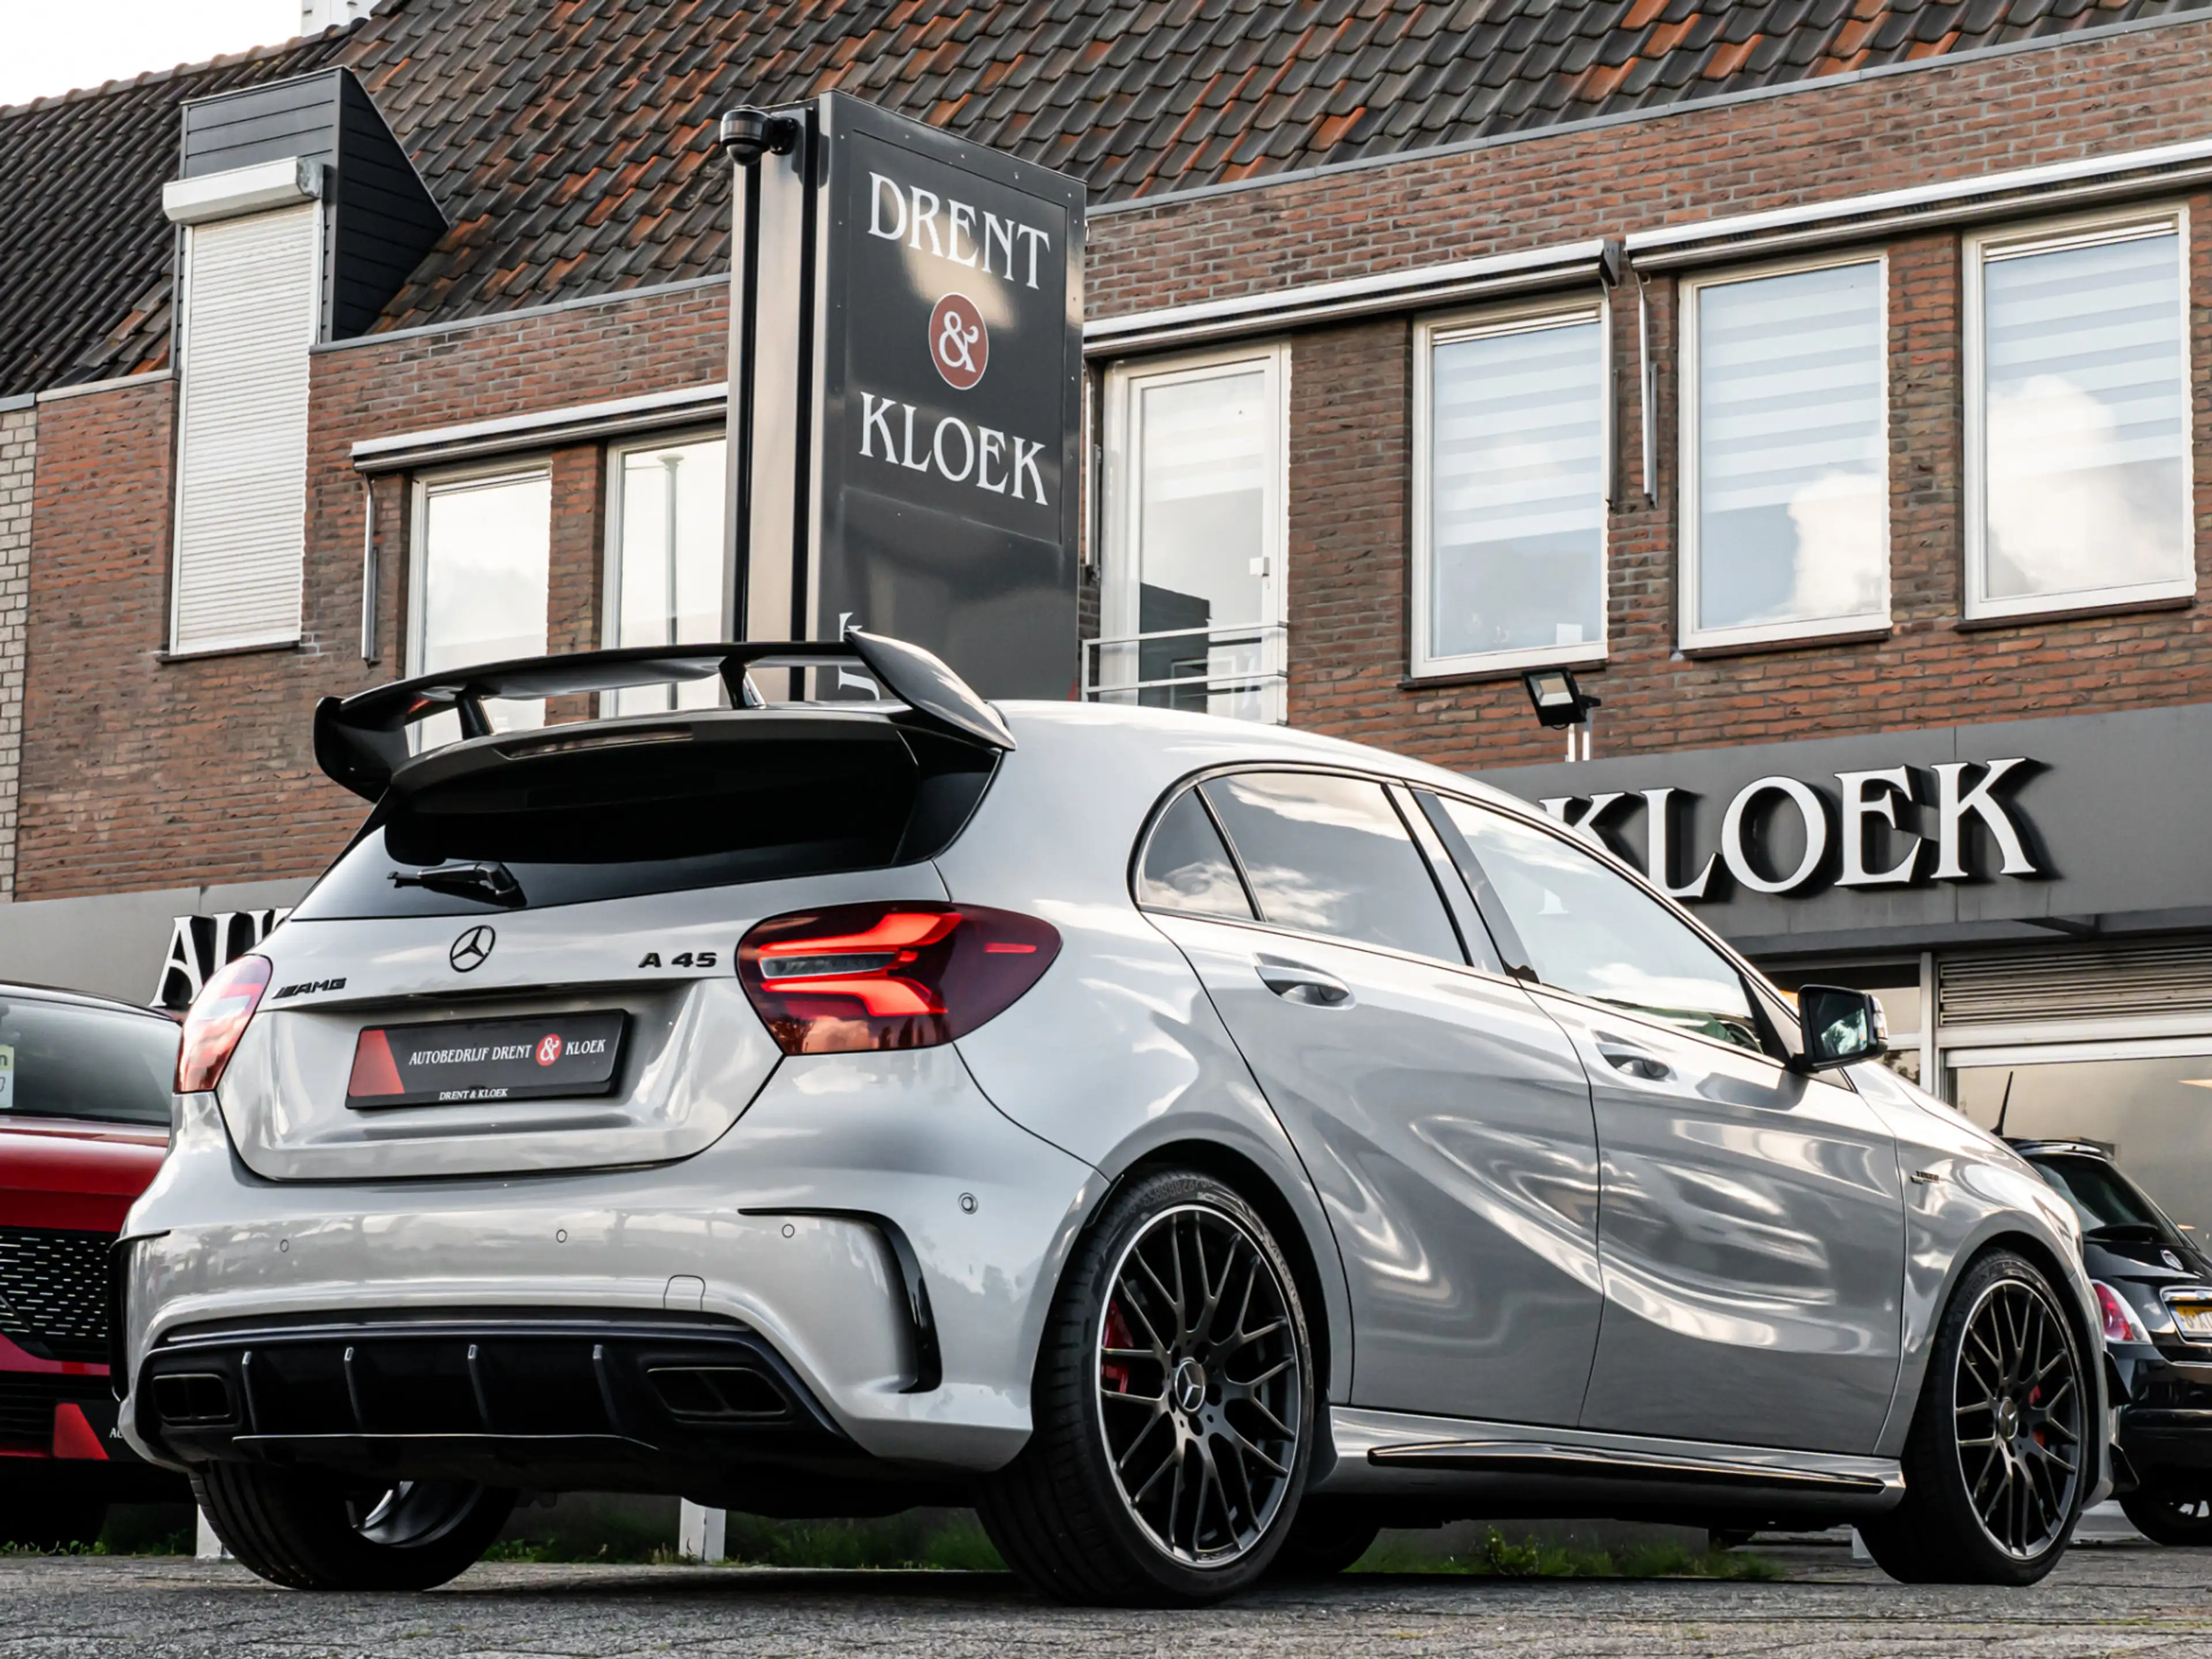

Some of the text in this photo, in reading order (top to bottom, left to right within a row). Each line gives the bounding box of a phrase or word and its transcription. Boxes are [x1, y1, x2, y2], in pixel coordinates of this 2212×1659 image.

[869, 172, 1050, 290] DRENT
[939, 311, 977, 373] &
[859, 392, 1048, 506] KLOEK
[638, 952, 718, 968] A 45
[408, 1037, 607, 1066] AUTOBEDRIJF DRENT & KLOEK
[438, 1090, 469, 1101] DRENT
[478, 1088, 509, 1099] KLOEK
